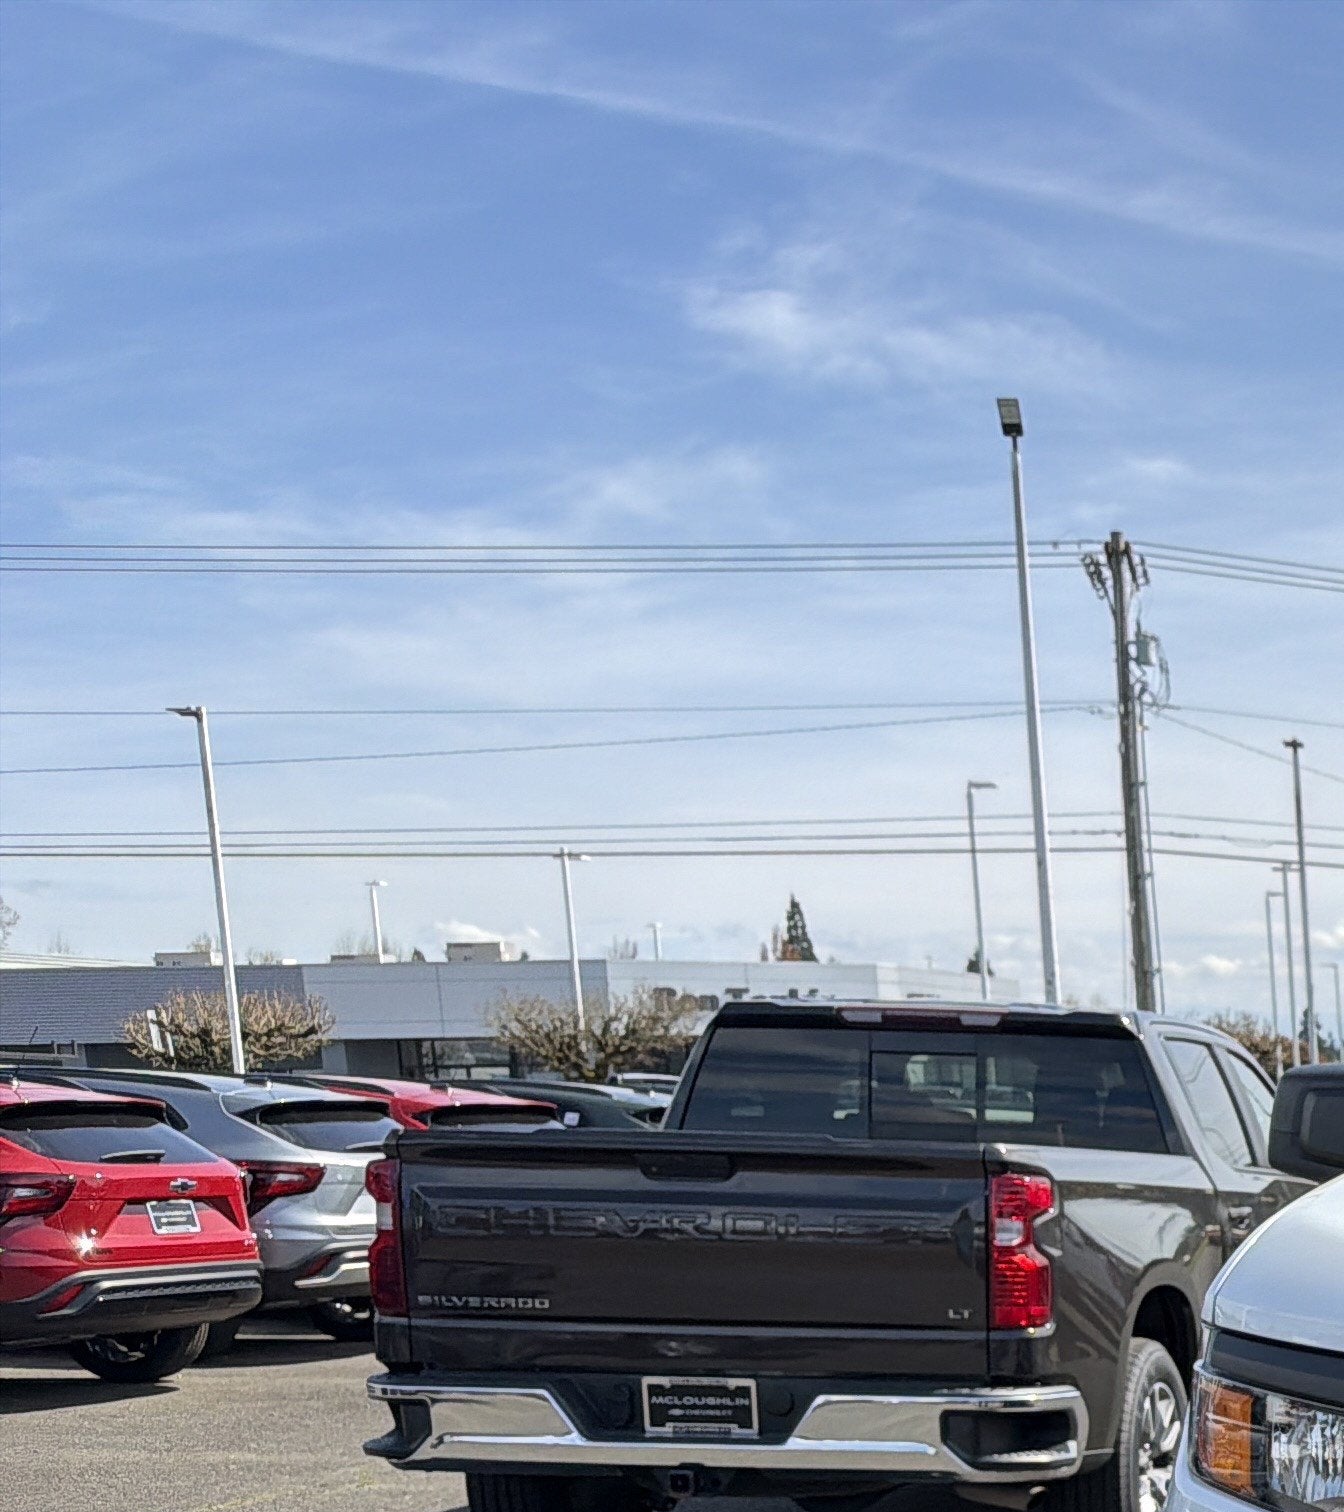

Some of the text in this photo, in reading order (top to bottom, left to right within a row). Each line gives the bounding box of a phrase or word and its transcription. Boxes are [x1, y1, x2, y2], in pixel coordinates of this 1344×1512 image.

[417, 1295, 550, 1308] SILVERADO
[948, 1308, 974, 1320] LT
[650, 1395, 749, 1406] MCLOUGHLIN
